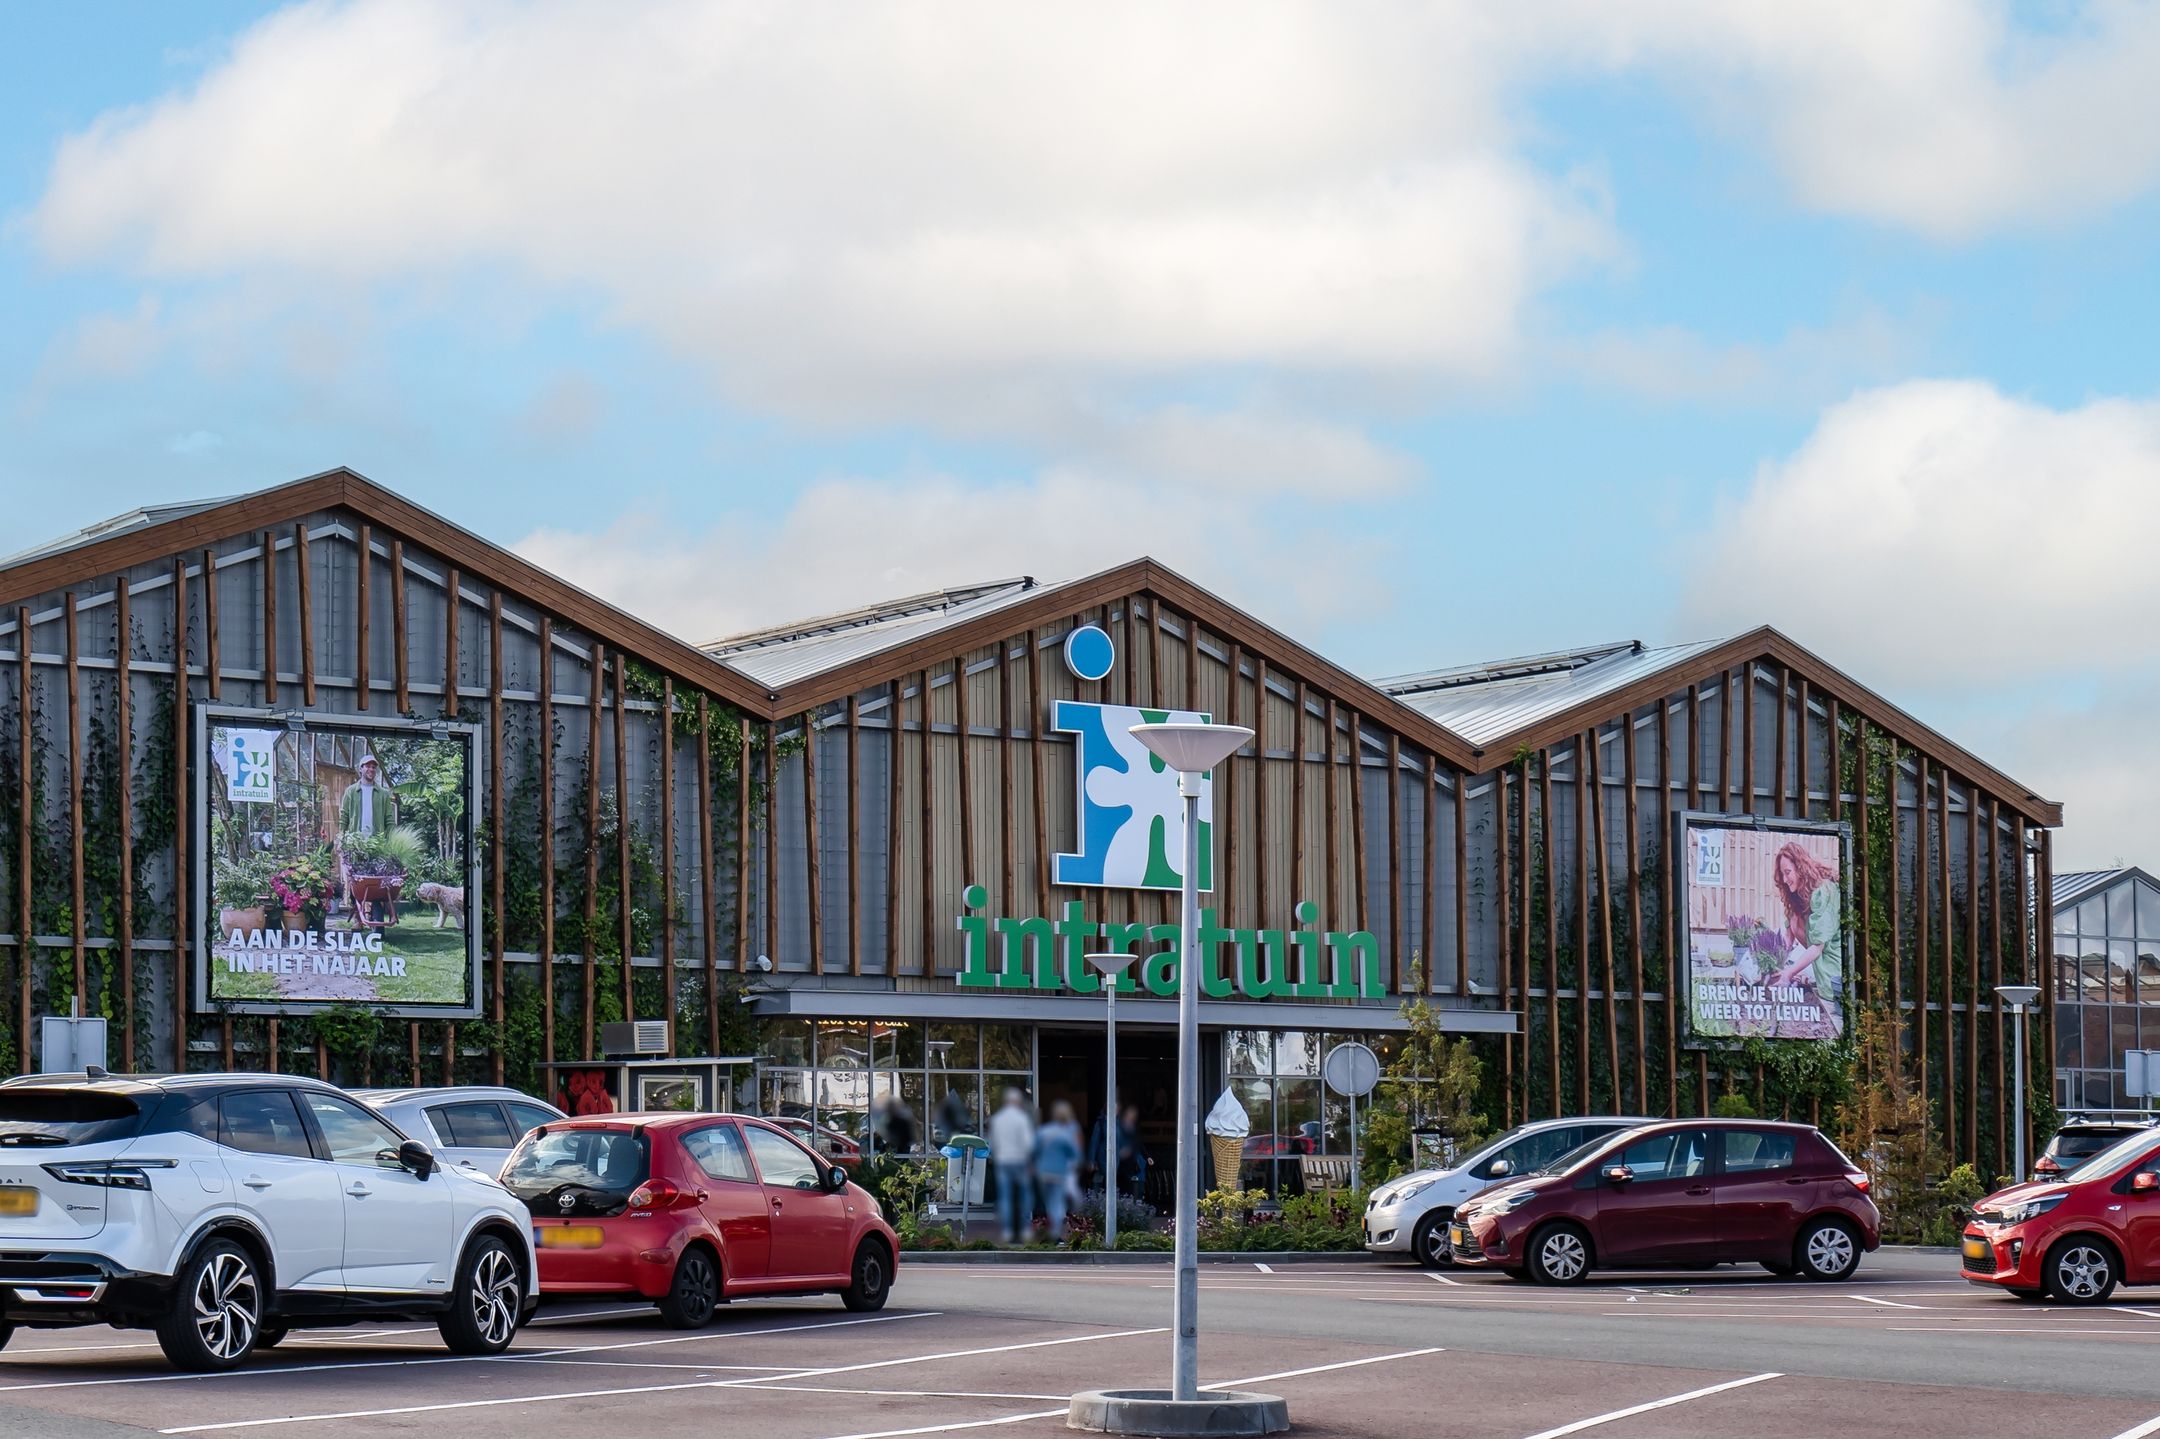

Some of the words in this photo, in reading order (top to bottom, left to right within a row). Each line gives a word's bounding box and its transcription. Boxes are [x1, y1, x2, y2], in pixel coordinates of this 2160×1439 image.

[233, 788, 269, 798] intratuin
[229, 928, 283, 950] AAN
[289, 930, 320, 951] DE
[324, 931, 383, 953] SLAG
[956, 885, 1387, 999] intratuin
[228, 953, 257, 973] IN
[261, 954, 306, 974] HET
[312, 955, 407, 977] NAJAAR
[1699, 985, 1748, 1002] BRENG
[1751, 986, 1768, 1002] JE
[1769, 986, 1804, 1003] TUIN
[1700, 1003, 1742, 1020] WEER
[1744, 1004, 1773, 1020] TOT
[1776, 1005, 1821, 1022] LEVEN
